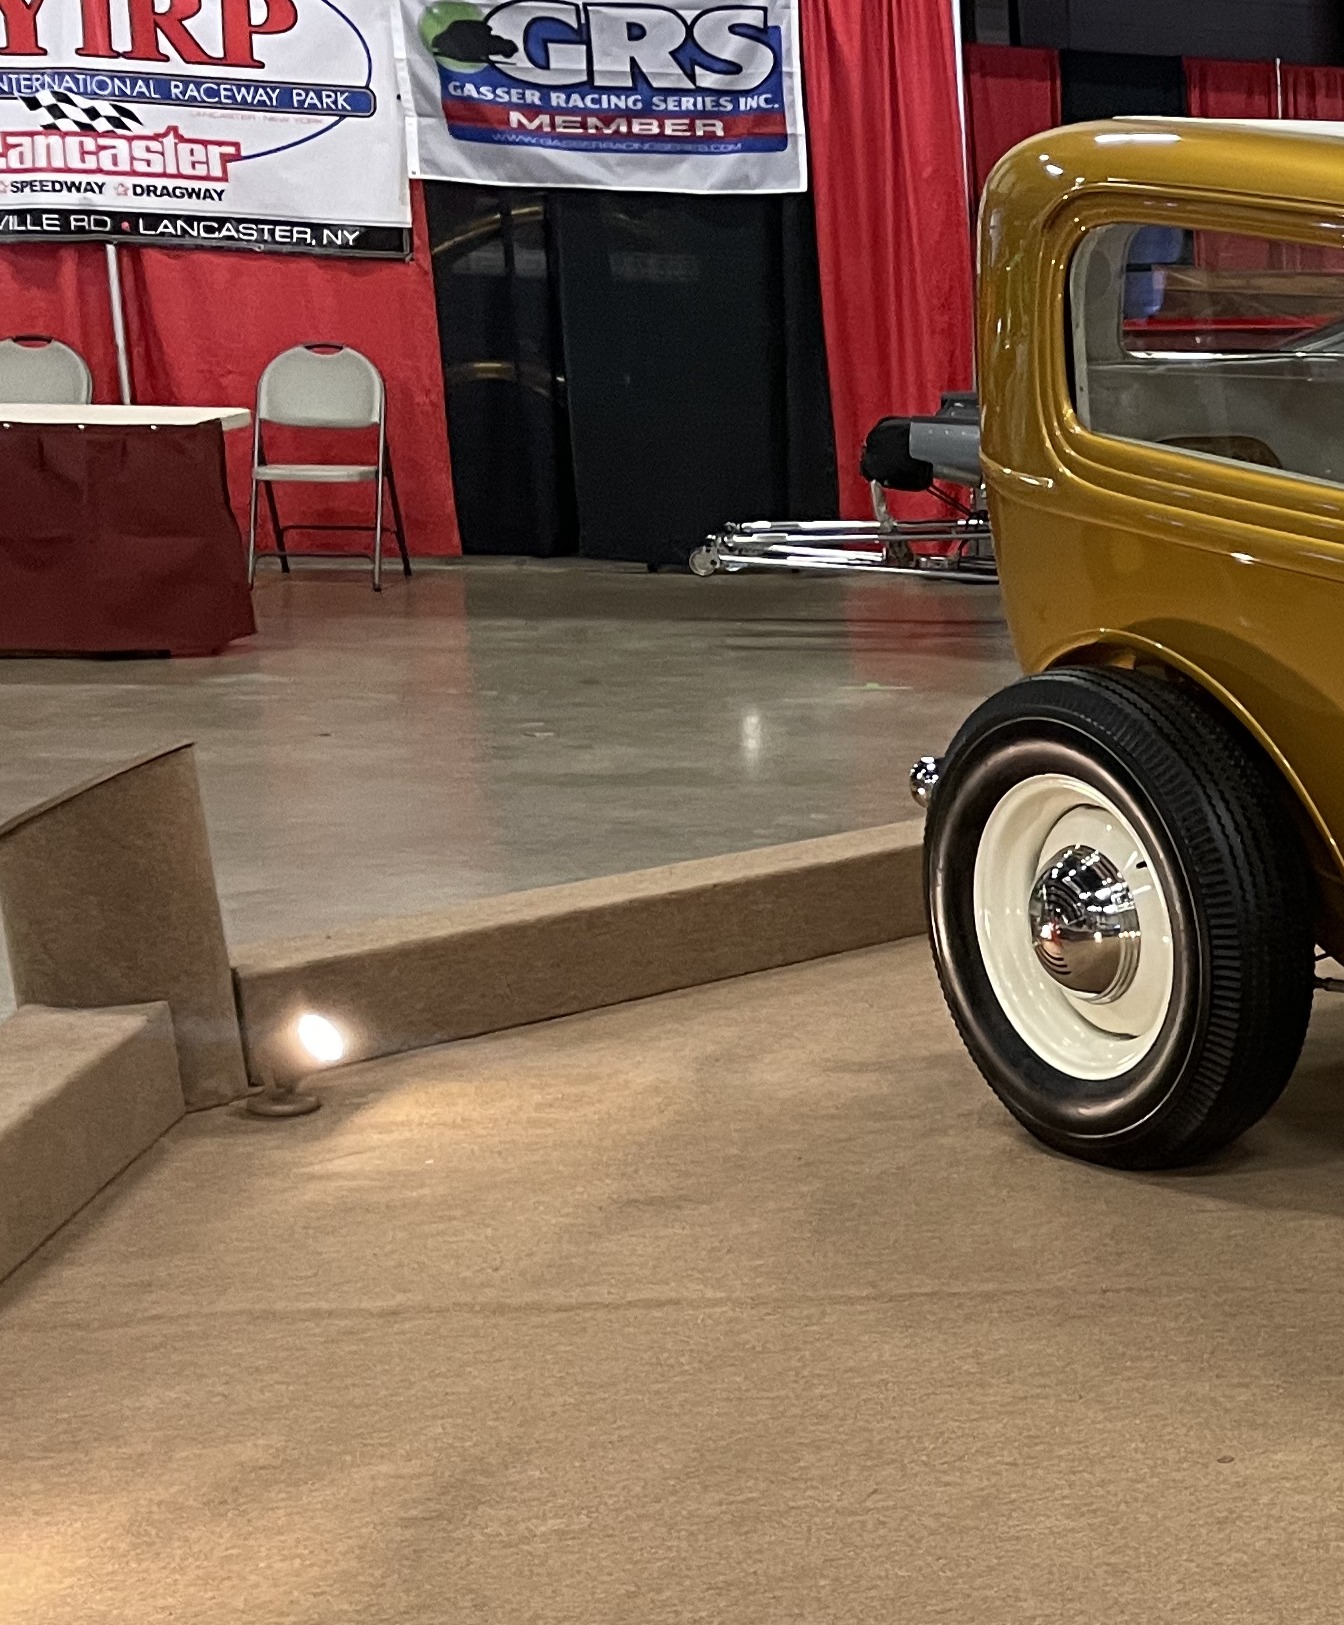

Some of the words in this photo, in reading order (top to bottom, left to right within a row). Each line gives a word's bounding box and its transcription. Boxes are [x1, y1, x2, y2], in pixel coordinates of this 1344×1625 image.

[484, 0, 776, 91] GRS
[171, 83, 280, 108] RACEWAY
[293, 89, 352, 111] PARK
[448, 81, 542, 106] GASSER
[555, 92, 643, 111] RACING
[652, 95, 732, 112] SERIES
[738, 94, 779, 112] INC.
[508, 111, 725, 137] MEMBER
[0, 129, 237, 178] ancaster
[10, 180, 106, 195] SPEEDWAY
[132, 184, 225, 201] DRAGWAY
[70, 215, 111, 232] RD
[139, 219, 316, 246] LANCASTER,
[323, 229, 360, 246] NY
